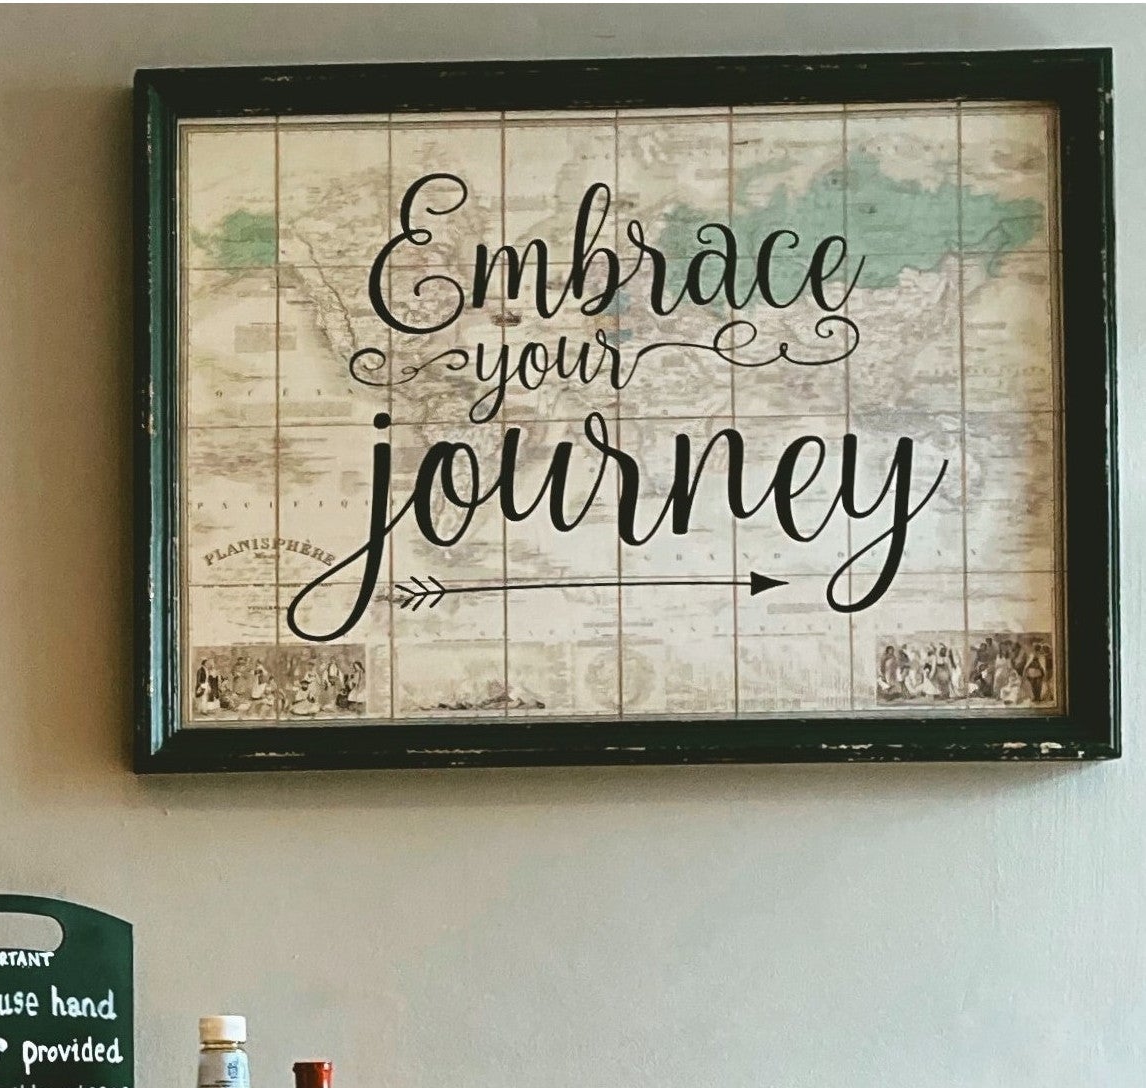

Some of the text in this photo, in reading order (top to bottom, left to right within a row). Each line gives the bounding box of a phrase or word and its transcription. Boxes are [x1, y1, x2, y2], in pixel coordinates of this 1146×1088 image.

[368, 173, 866, 334] Embrace
[468, 329, 642, 424] your
[286, 411, 948, 642] journey
[51, 985, 118, 1020] hand
[22, 1036, 124, 1076] provided
